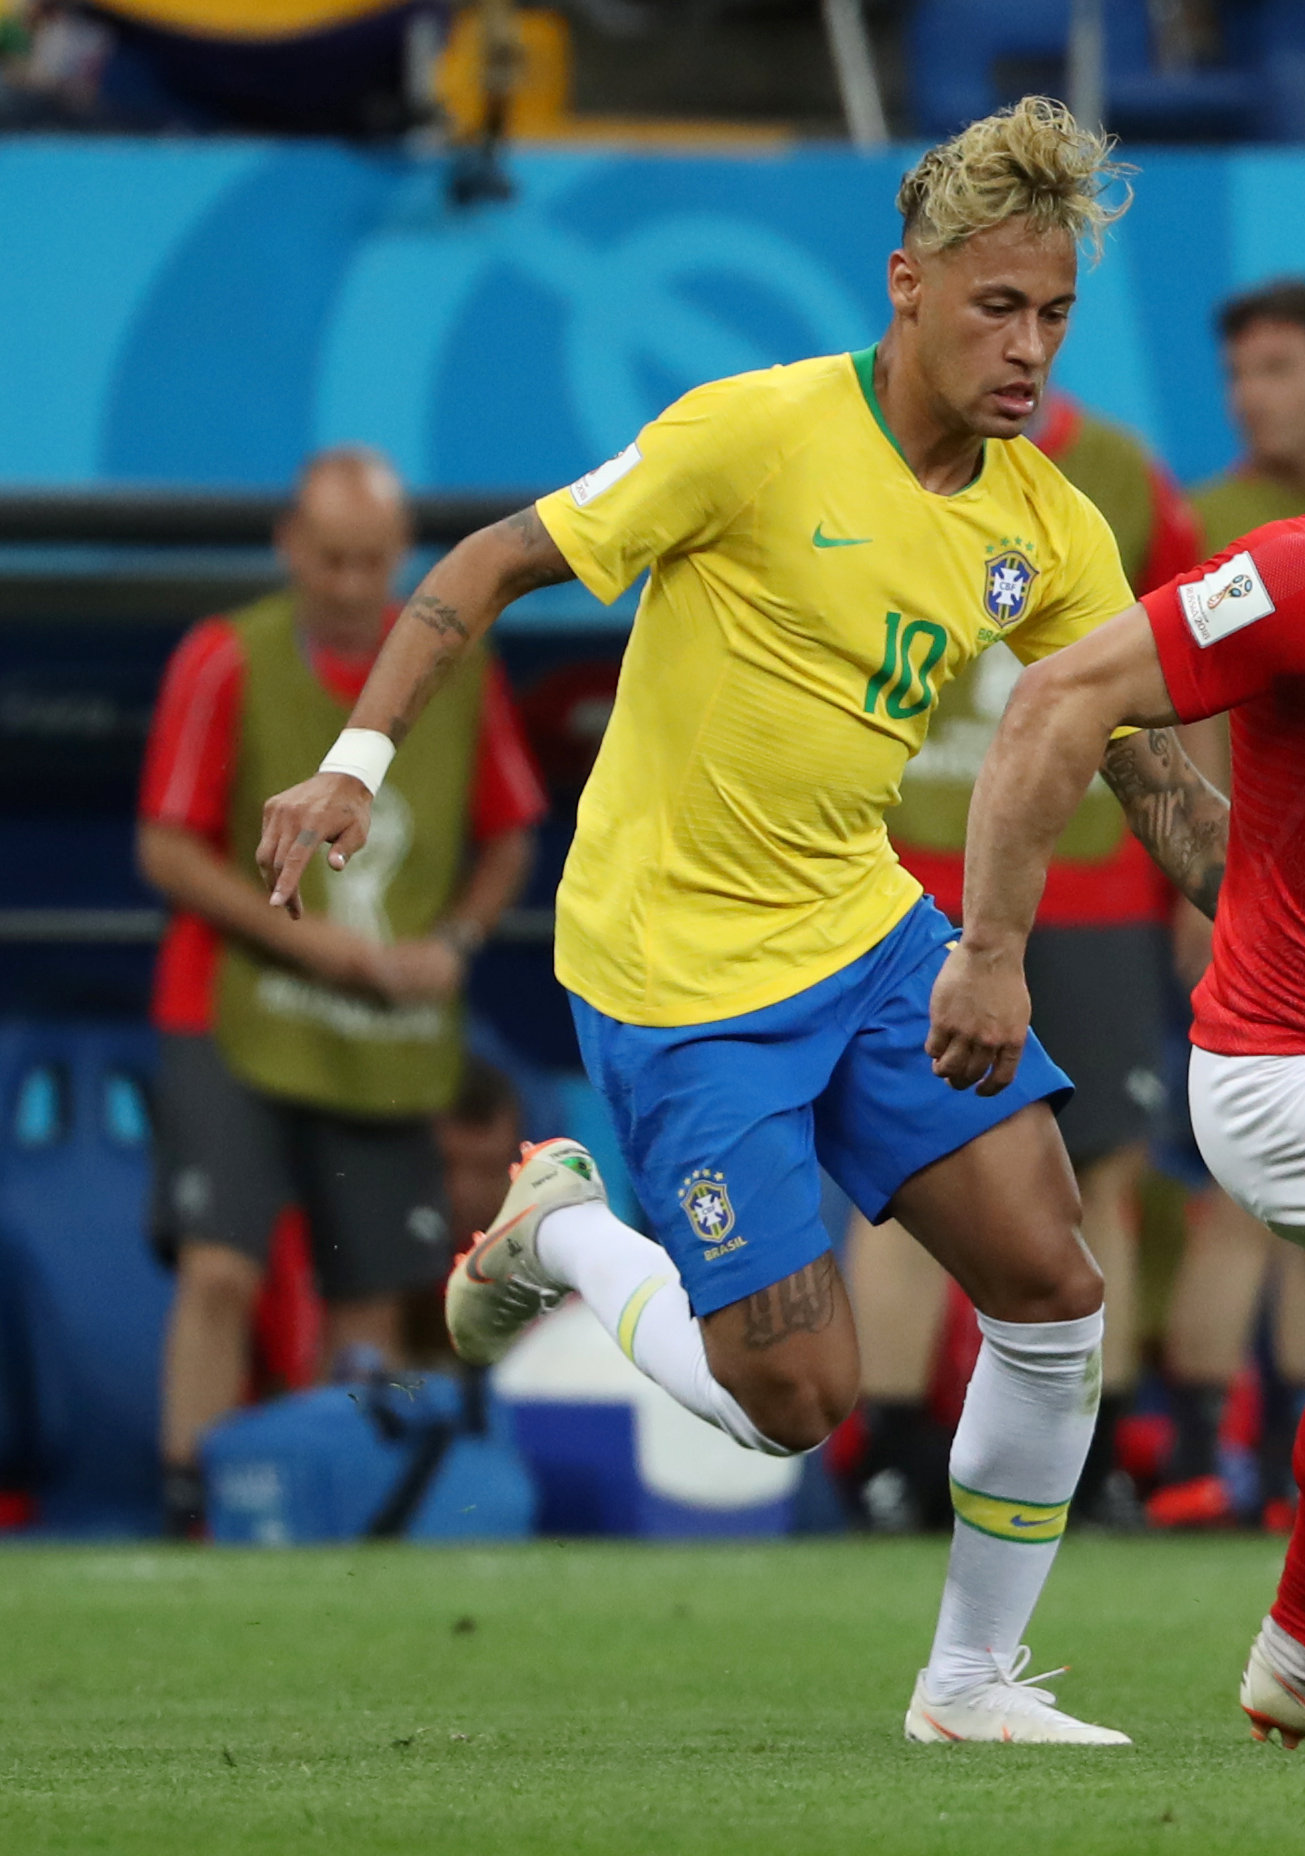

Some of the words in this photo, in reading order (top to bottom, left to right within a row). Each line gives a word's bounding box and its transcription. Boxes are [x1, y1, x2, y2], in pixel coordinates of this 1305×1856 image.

[1194, 618, 1211, 641] 2018
[863, 611, 948, 719] 10
[703, 1235, 749, 1262] BRASIL
